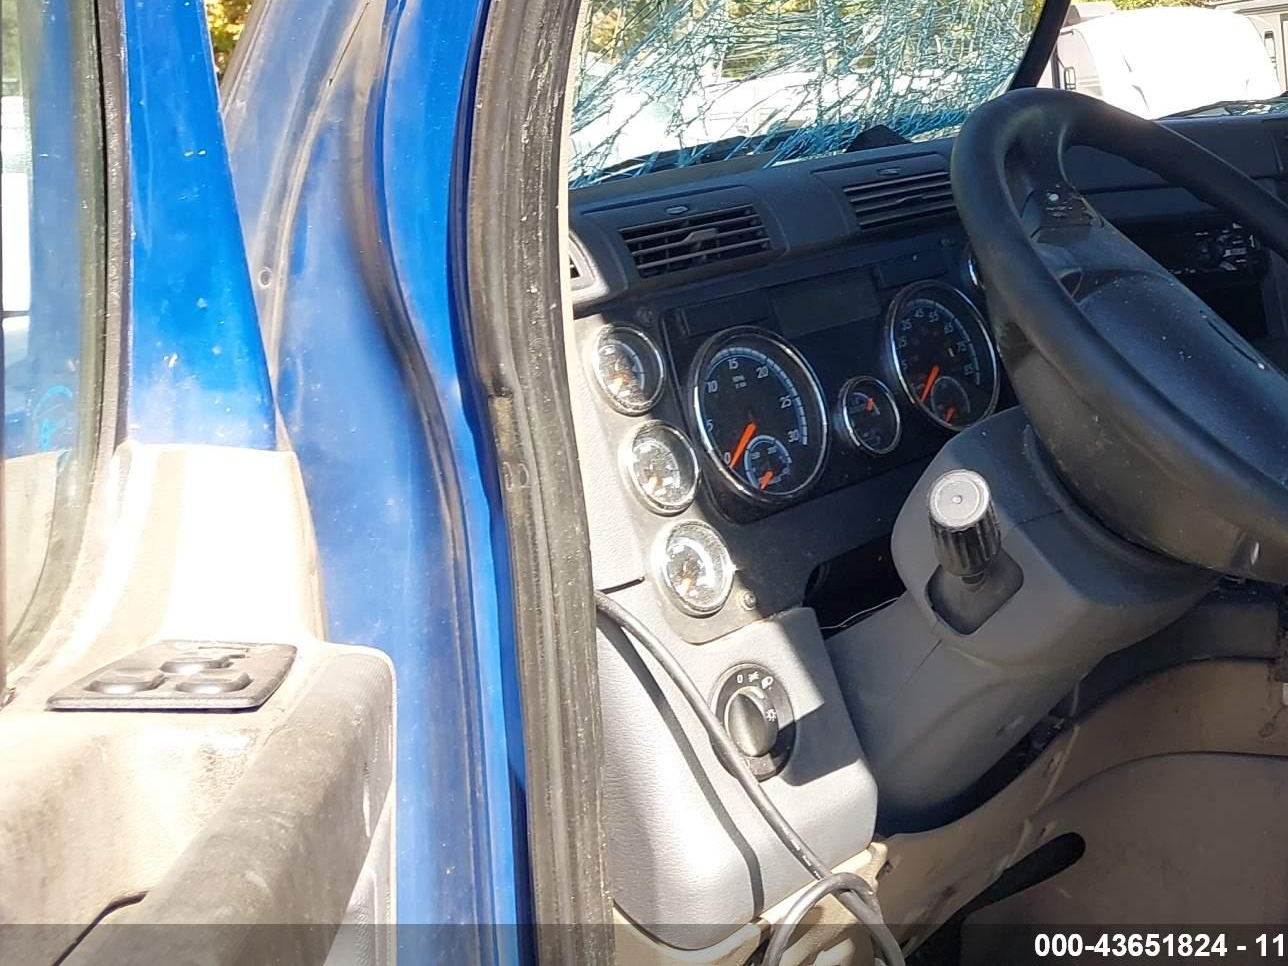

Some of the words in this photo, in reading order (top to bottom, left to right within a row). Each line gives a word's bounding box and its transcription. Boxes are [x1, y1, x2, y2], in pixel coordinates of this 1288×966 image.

[728, 357, 738, 370] 15
[756, 367, 769, 379] 20
[707, 381, 718, 393] 10
[779, 396, 792, 409] 25
[706, 419, 713, 431] 5
[788, 429, 800, 442] 30
[724, 452, 731, 463] 0
